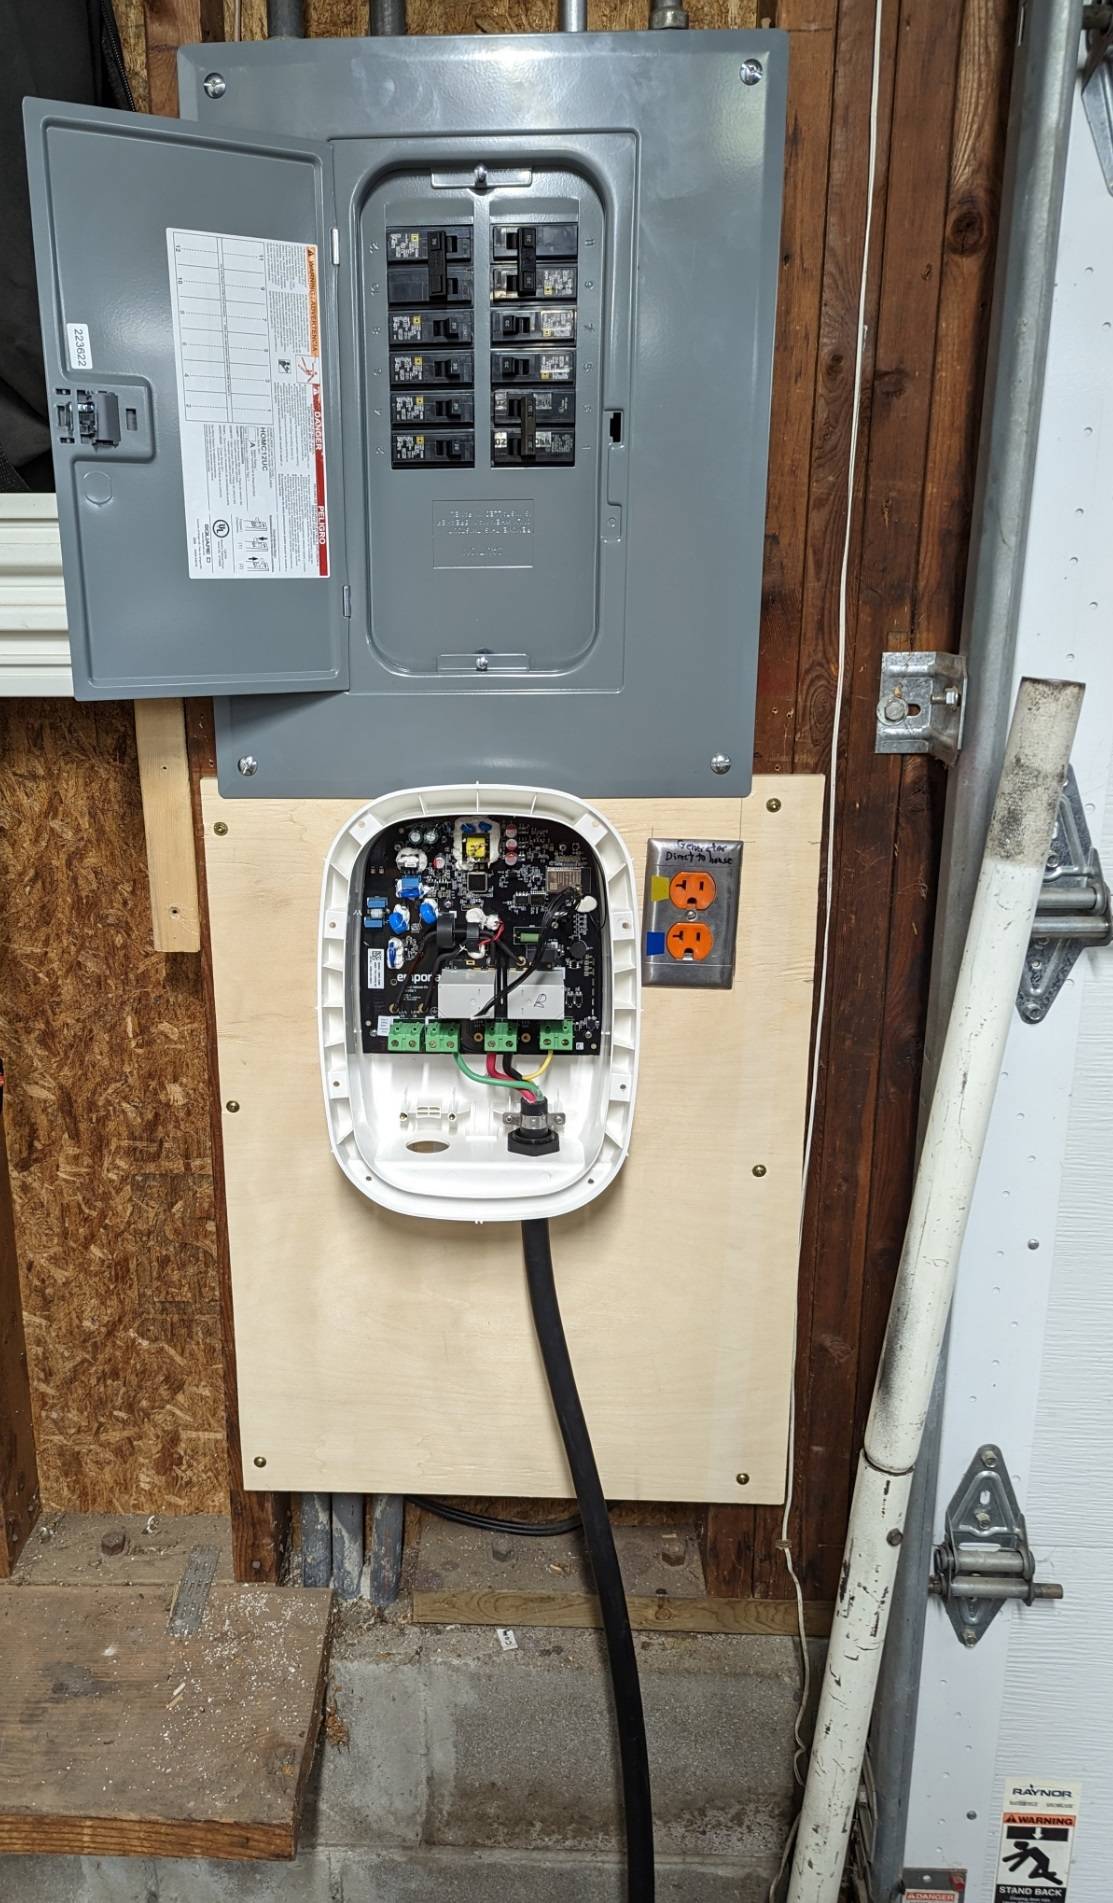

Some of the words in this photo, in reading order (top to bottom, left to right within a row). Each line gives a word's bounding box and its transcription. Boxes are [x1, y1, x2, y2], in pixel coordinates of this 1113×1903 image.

[308, 261, 316, 295] WARNING
[74, 328, 86, 367] 223622
[314, 411, 322, 450] DANGER
[260, 427, 268, 471] HOMC12UC
[318, 505, 326, 545] PELIGRO
[695, 852, 706, 862] to
[397, 973, 442, 984] epora
[1012, 1786, 1073, 1798] RAYNOR
[1018, 1815, 1073, 1826] WARNING
[916, 1893, 954, 1901] DANGER
[999, 1886, 1033, 1896] STAND
[1034, 1888, 1063, 1897] BACK
